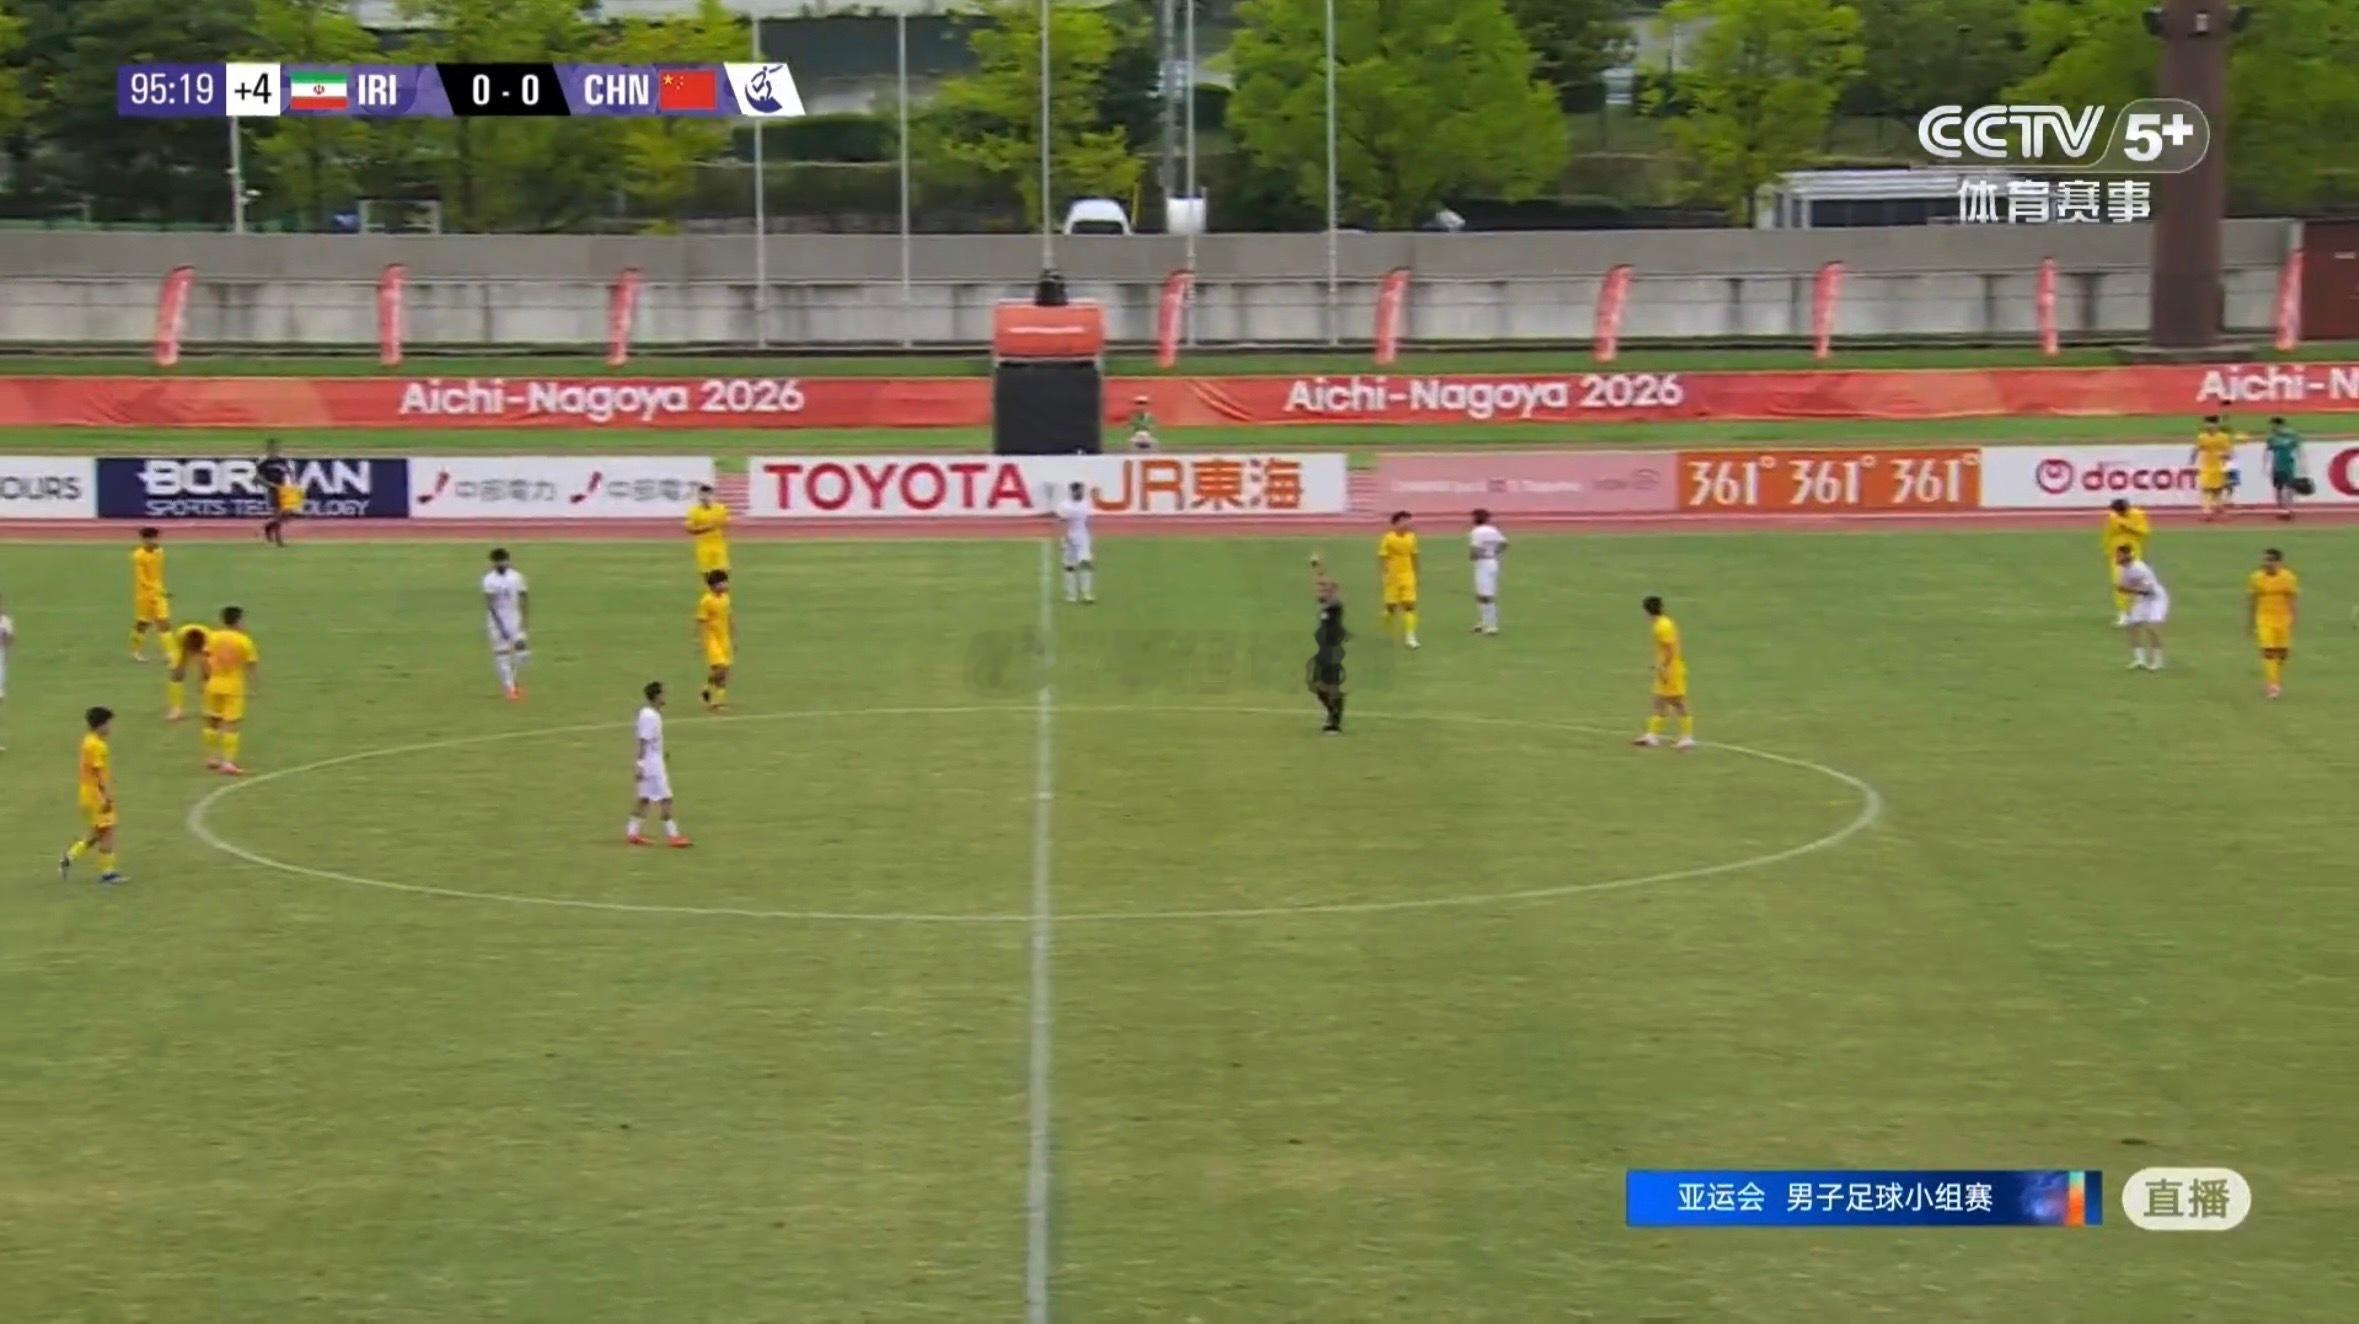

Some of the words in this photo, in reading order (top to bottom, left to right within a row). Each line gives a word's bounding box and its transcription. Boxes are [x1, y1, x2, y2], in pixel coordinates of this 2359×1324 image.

[400, 378, 689, 423] Aichi-Nagoya
[700, 378, 805, 413] 2026
[1284, 376, 1568, 419] Aichi-Nagoya
[1579, 374, 1683, 408] 2026
[137, 459, 372, 495] BORAN
[763, 462, 1032, 510] TOYOTA
[1090, 458, 1305, 511] JR東海
[2081, 461, 2201, 491] docom
